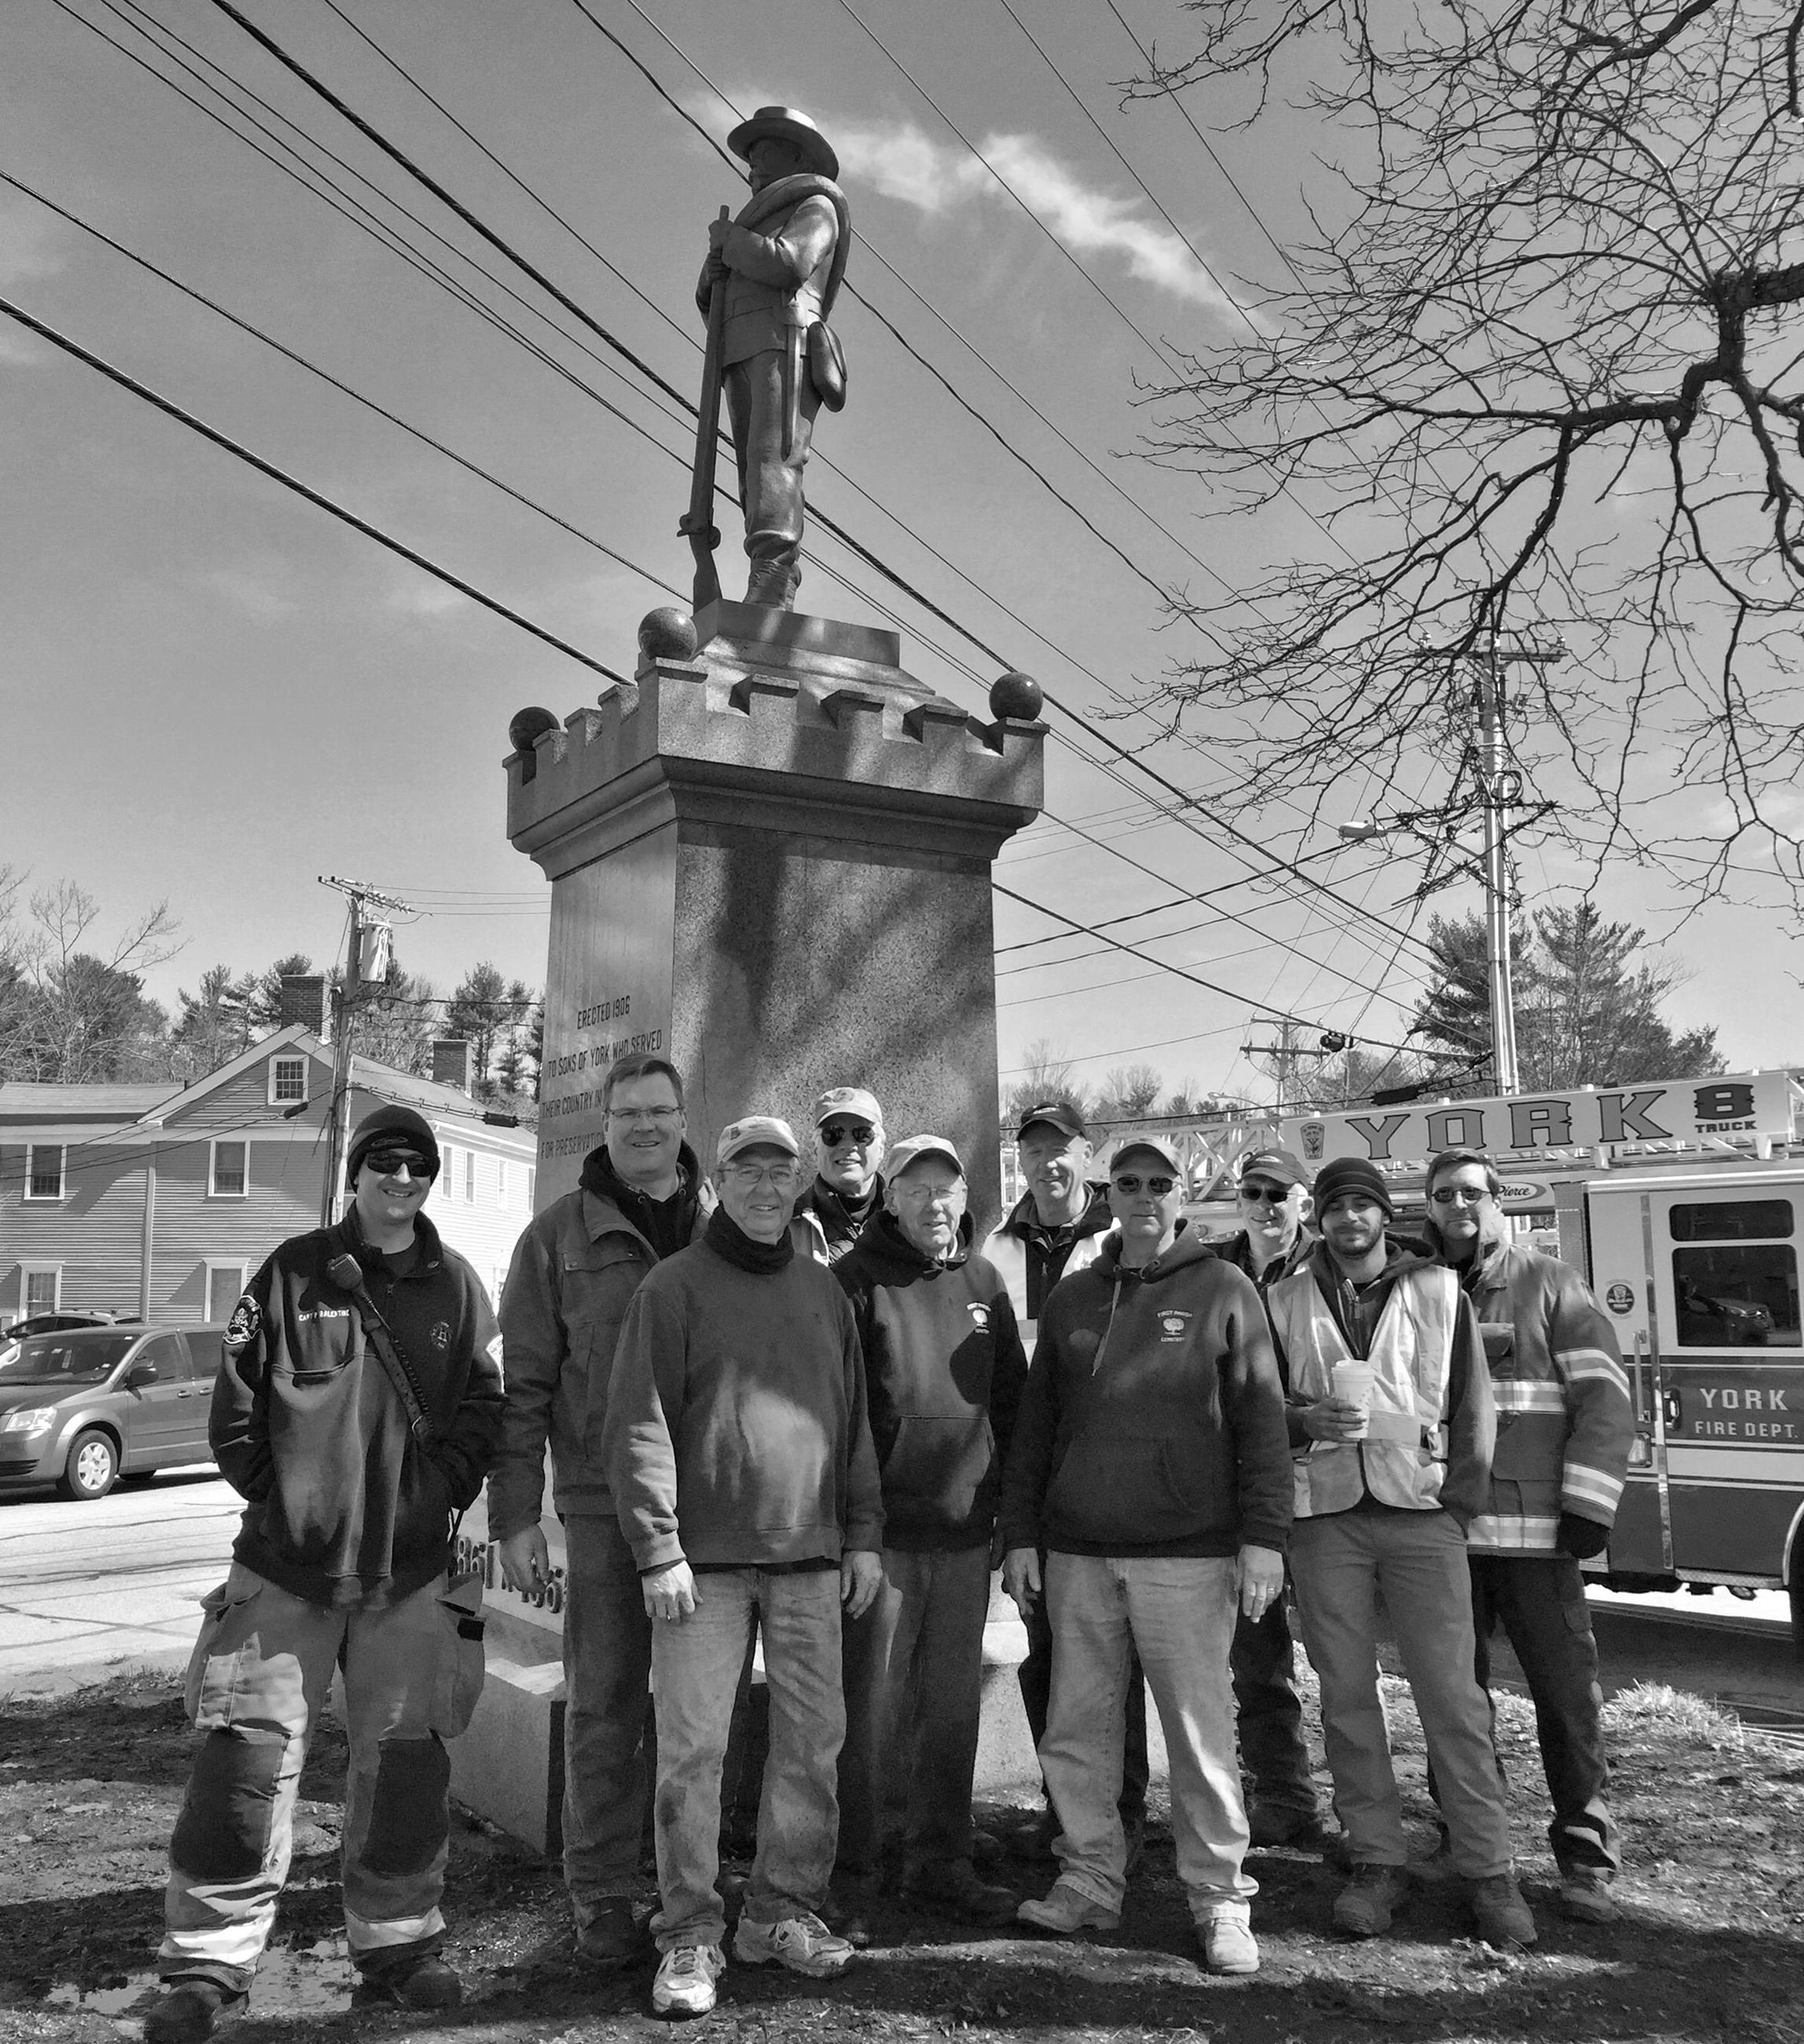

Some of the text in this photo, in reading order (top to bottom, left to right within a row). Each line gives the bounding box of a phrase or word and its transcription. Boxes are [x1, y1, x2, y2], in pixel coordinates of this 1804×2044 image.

[577, 995, 630, 1030] ERECTED 1906
[548, 1029, 662, 1078] TO SONS OF YORK WHO SERVED
[542, 1098, 560, 1119] THEIR
[562, 1091, 593, 1115] COUNTRY
[1345, 1083, 1755, 1160] YORK 8
[1695, 1120, 1757, 1134] TRUCK
[540, 1141, 553, 1160] FOR
[1699, 1388, 1789, 1410] YORK
[1695, 1421, 1798, 1438] FIRE DEPT.
